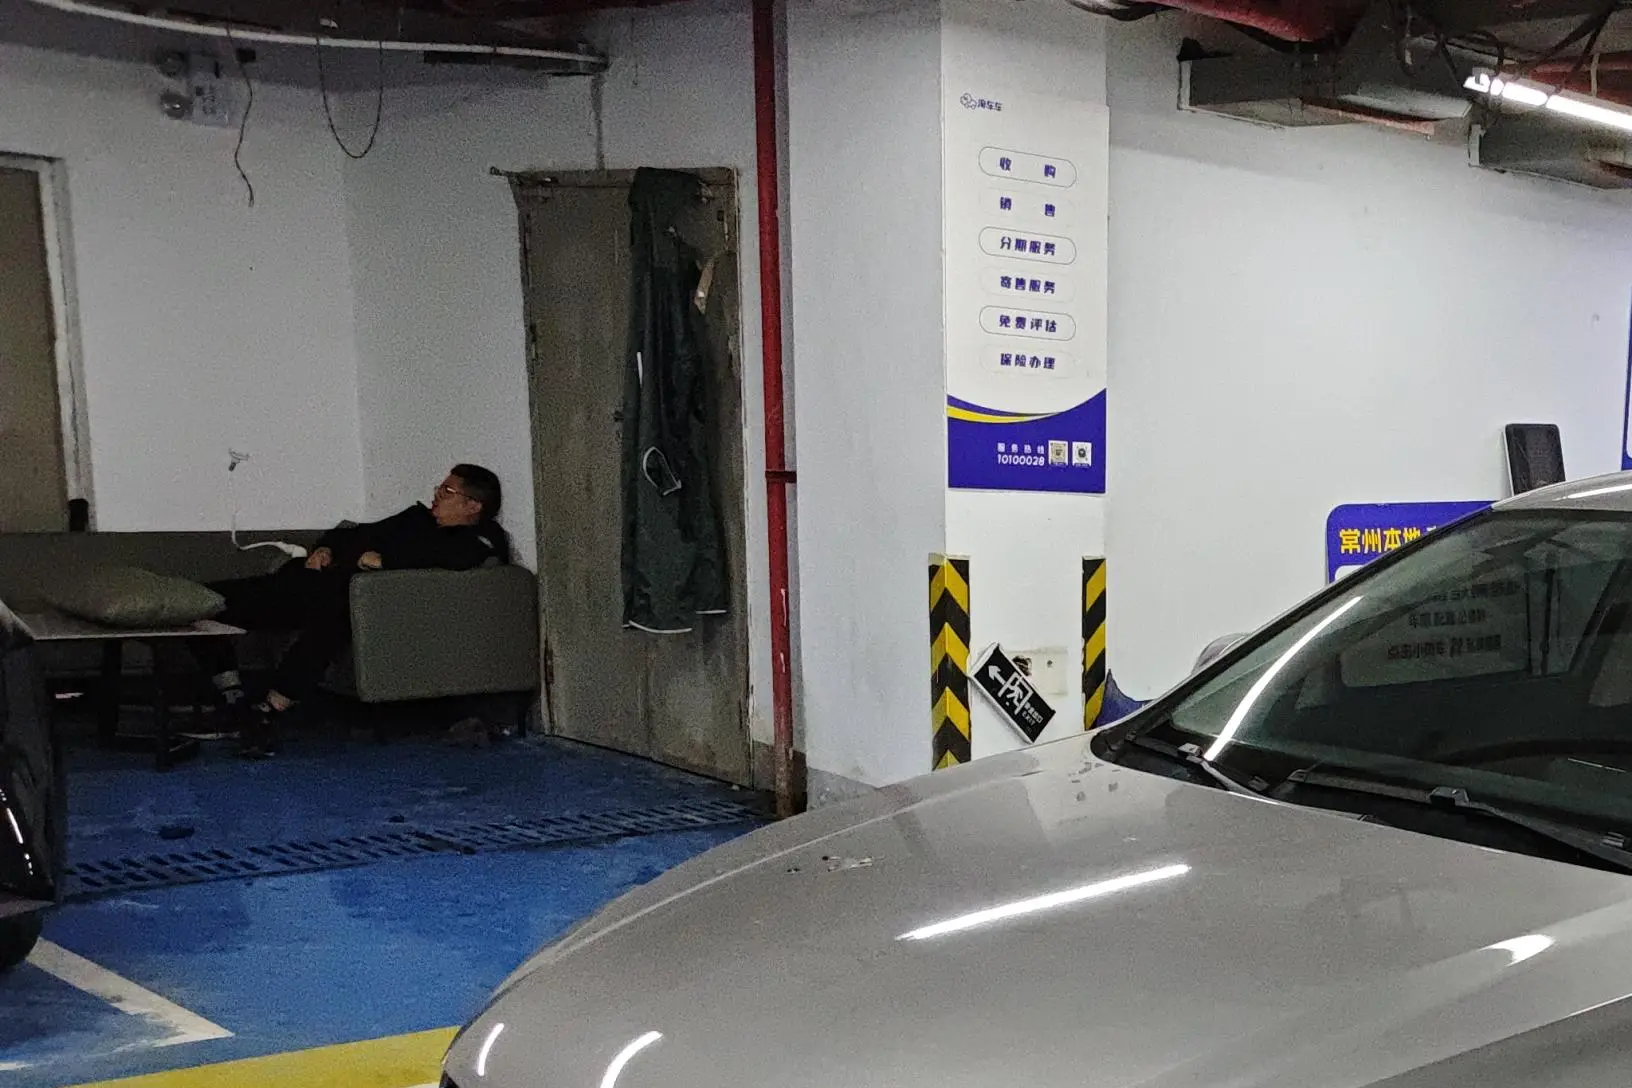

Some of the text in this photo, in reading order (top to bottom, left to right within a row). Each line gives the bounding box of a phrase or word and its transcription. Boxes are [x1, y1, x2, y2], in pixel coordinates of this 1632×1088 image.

[1000, 236, 1056, 256] 分期服务
[1000, 275, 1056, 294] 寄售服务
[999, 314, 1057, 333] 免费评估
[1000, 353, 1056, 370] 保险办理
[997, 454, 1045, 466] 10100028
[1022, 711, 1036, 726] EXIT
